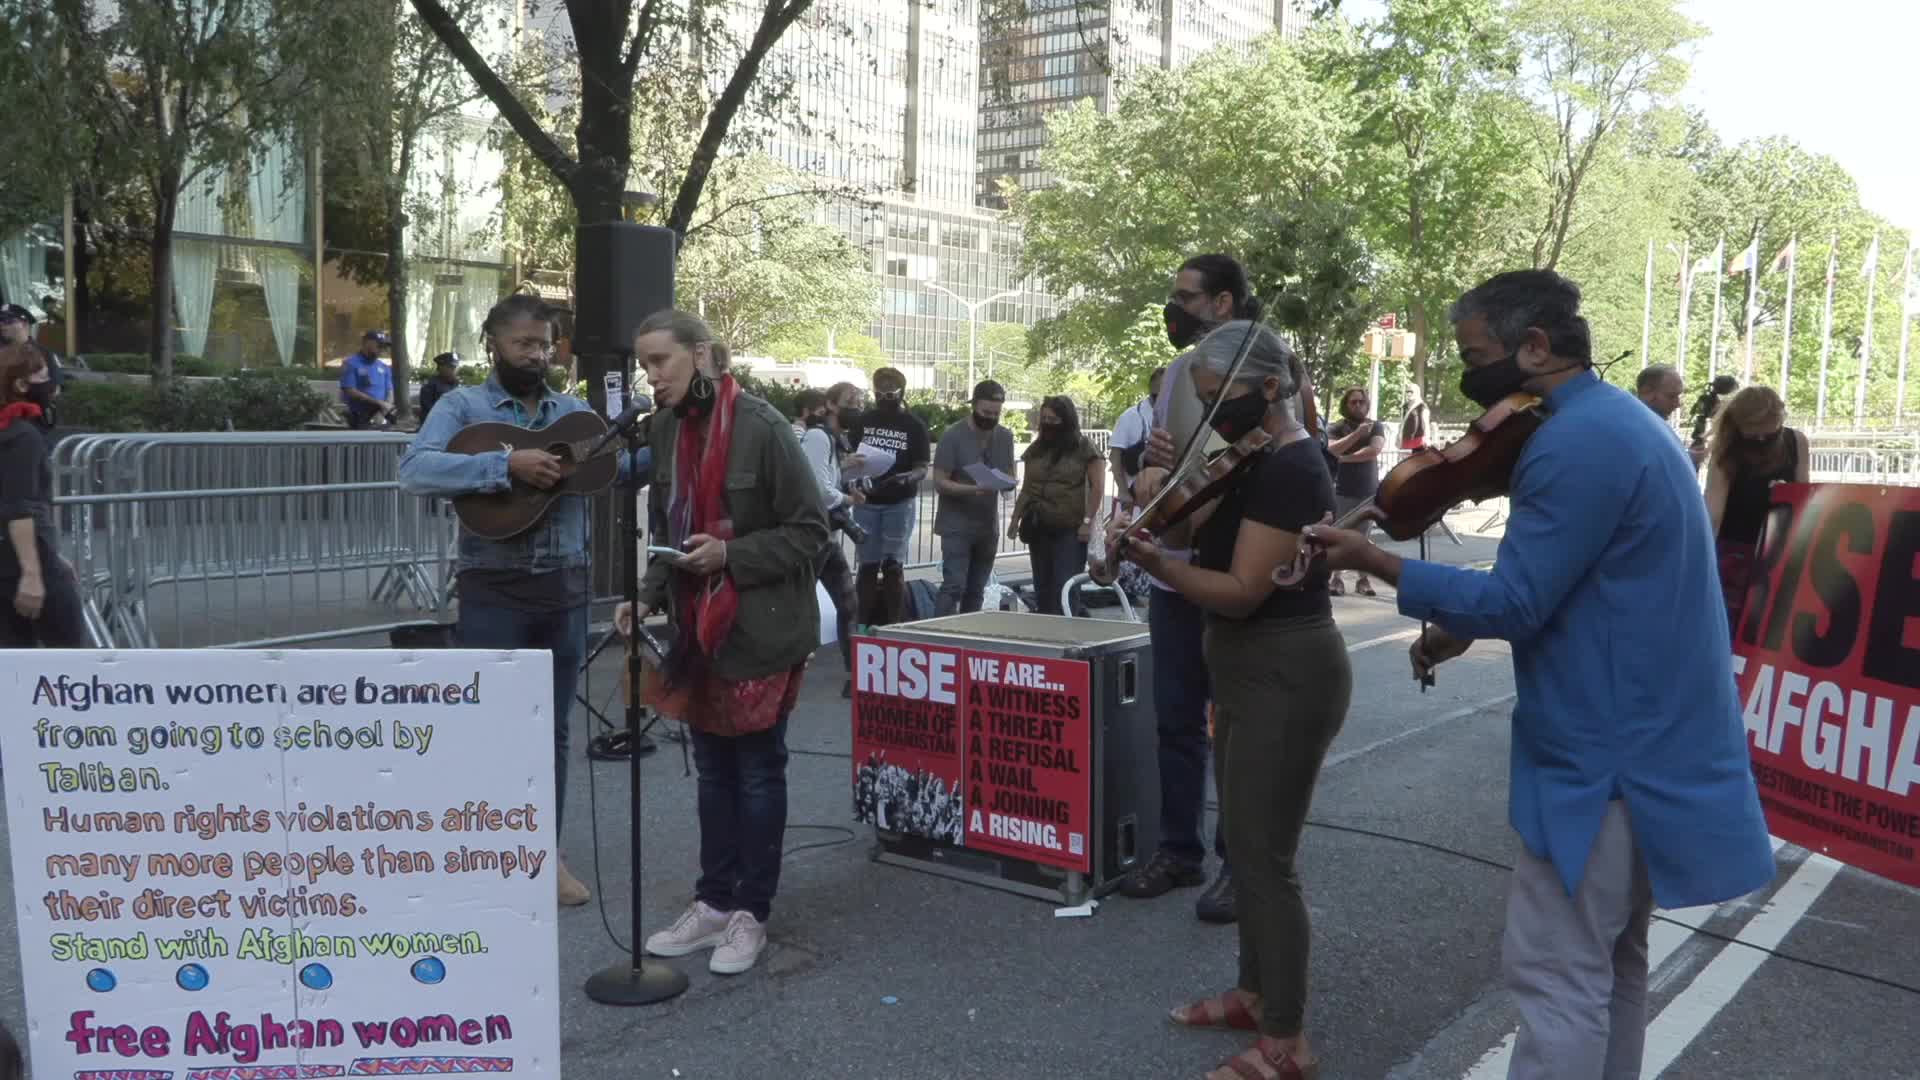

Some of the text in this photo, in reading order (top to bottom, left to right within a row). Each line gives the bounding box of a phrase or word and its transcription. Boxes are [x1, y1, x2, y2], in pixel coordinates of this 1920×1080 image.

[32, 671, 481, 711] Afghan women are banned
[856, 643, 956, 704] RISE
[968, 656, 1065, 691] WE ARE...
[858, 703, 957, 737] WOMEN OF
[970, 685, 1081, 720] A WITNESS
[33, 718, 433, 755] from going to school by
[970, 710, 1065, 744] A THREAT
[970, 736, 983, 757] A
[988, 738, 1081, 774] REFUSAL
[39, 762, 170, 793] Taliban.
[970, 761, 1037, 793] A WAIL
[43, 801, 538, 840] Human rights violations affect
[970, 787, 1070, 825] A JOINING
[1832, 791, 1862, 820] THE
[970, 810, 1062, 850] A RISING.
[46, 844, 546, 884] many more people than simply
[43, 885, 367, 921] their direct victims.
[50, 927, 488, 965] Stand with Afghan women.
[66, 1010, 512, 1063] free Afghan women
